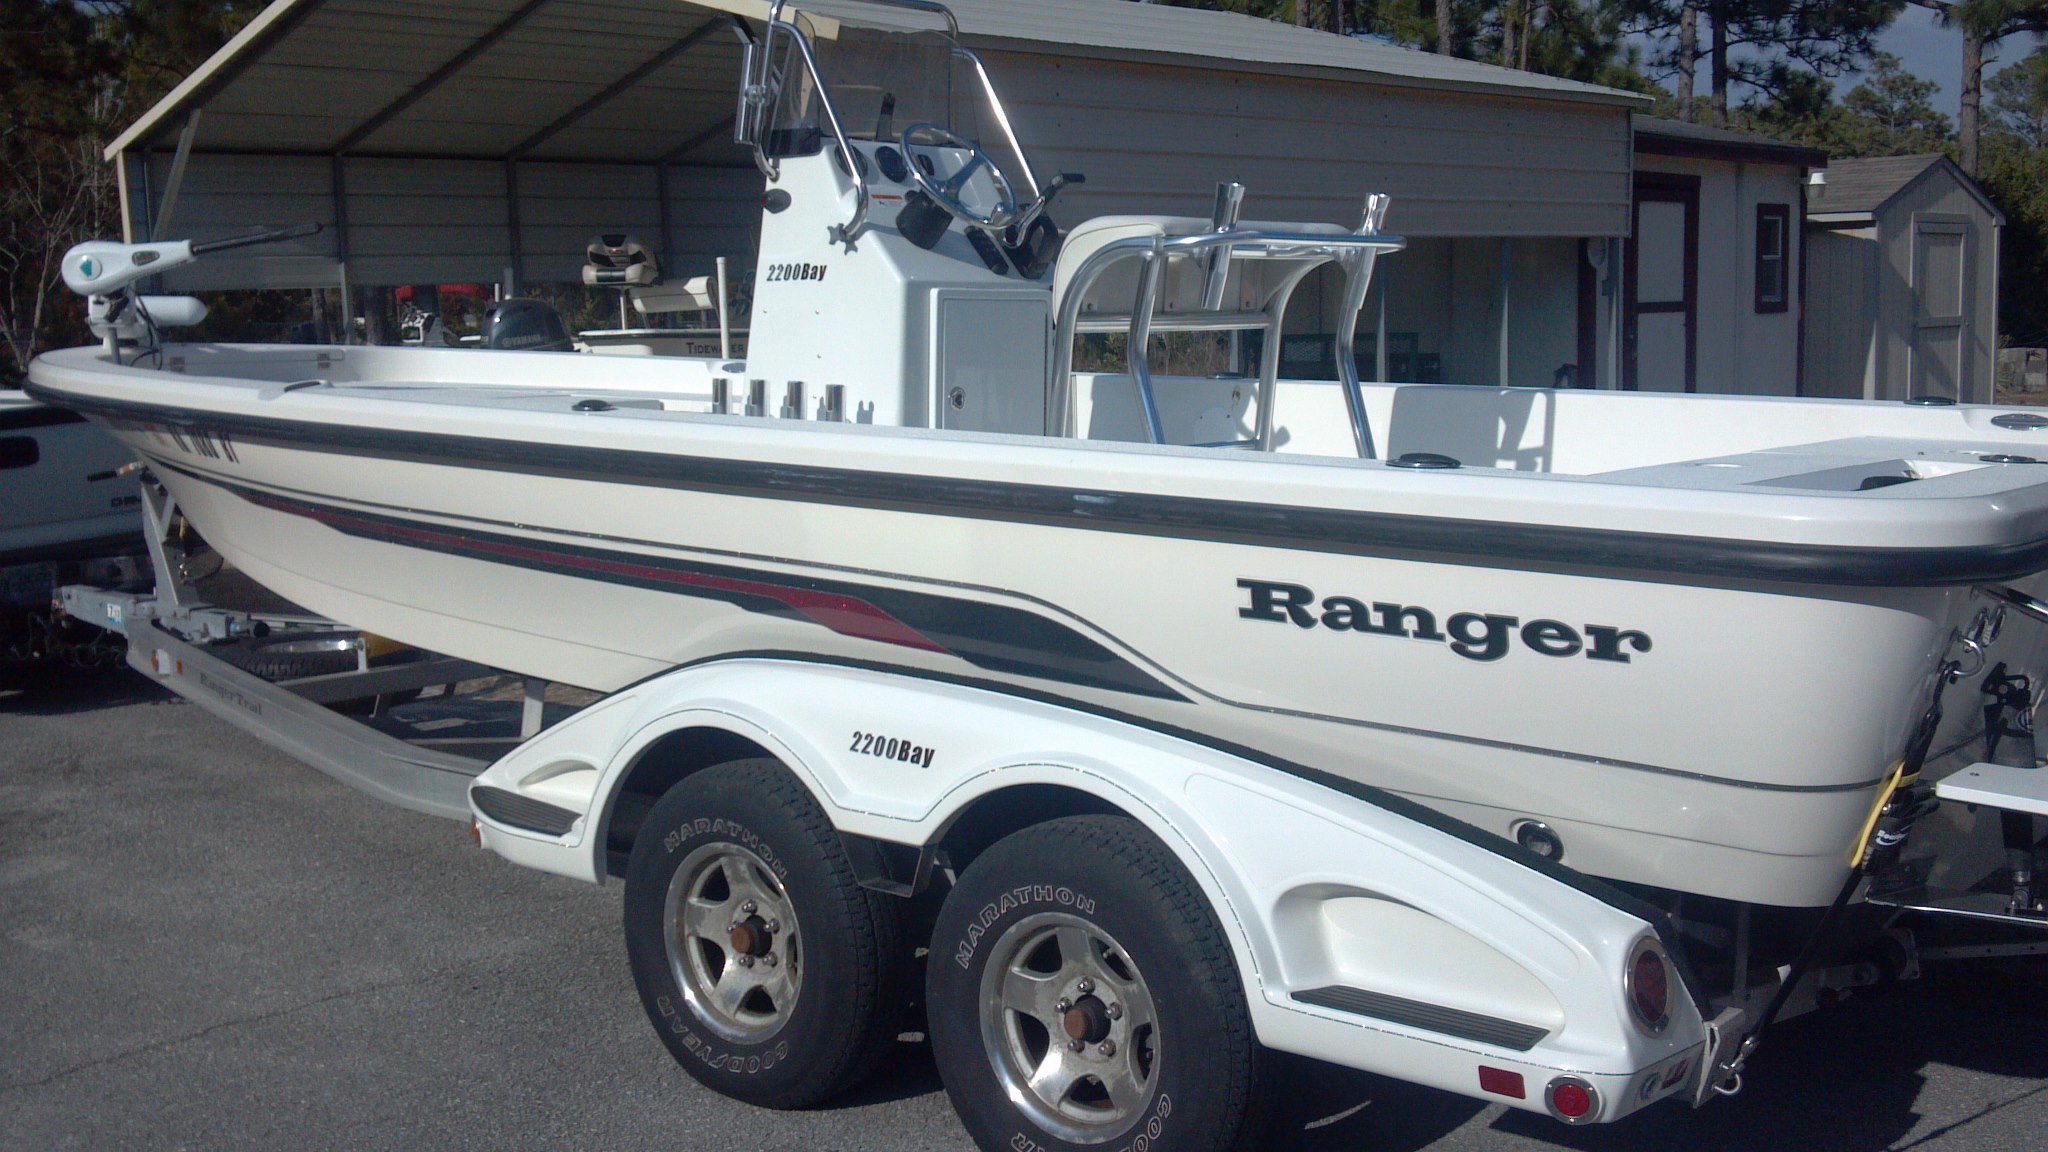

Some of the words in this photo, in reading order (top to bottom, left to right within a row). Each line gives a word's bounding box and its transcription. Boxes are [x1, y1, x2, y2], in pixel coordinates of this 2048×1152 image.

[766, 263, 827, 281] 2200Bay
[1236, 577, 1653, 663] Ranger
[849, 730, 935, 768] 2200Bay
[664, 817, 787, 880] MARATHON
[955, 885, 1096, 969] MARATHON
[657, 996, 788, 1074] GOODYEAR
